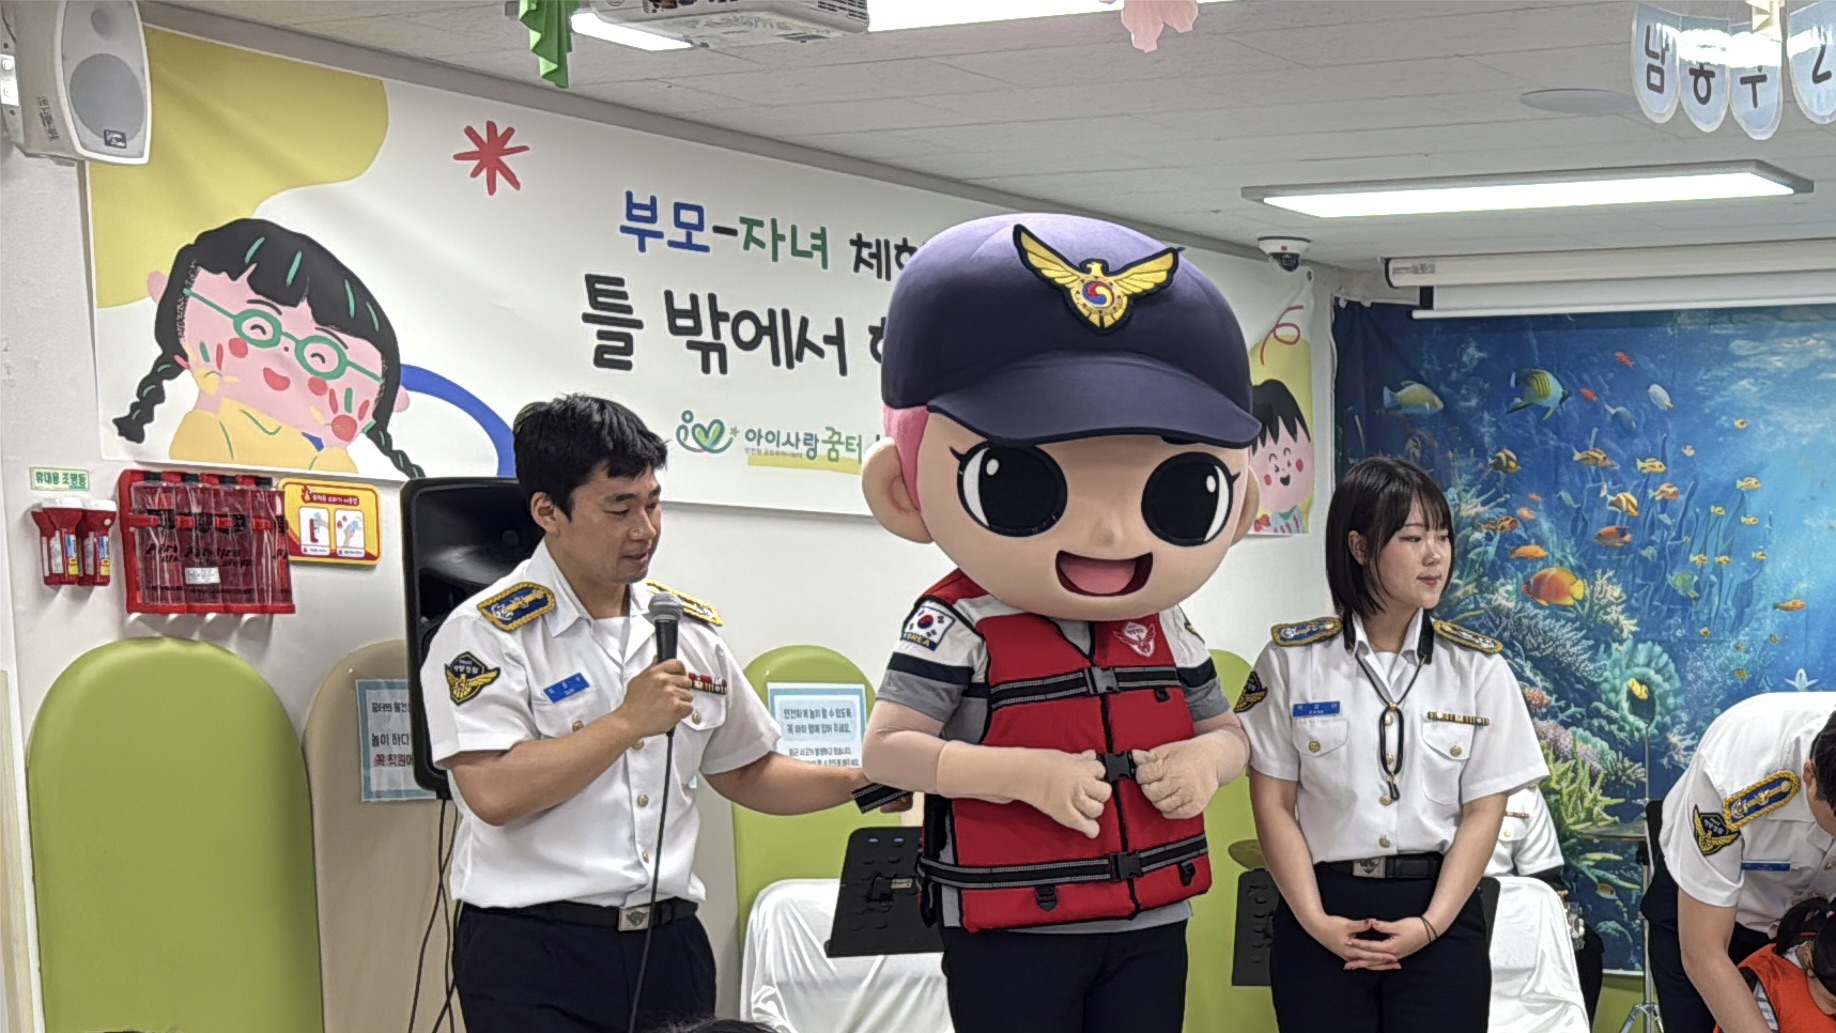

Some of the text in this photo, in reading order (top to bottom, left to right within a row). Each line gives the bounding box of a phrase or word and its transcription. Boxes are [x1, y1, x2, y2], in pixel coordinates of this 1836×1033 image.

[619, 190, 918, 281] 부모-자녀 체
[581, 273, 644, 371] 틀
[663, 289, 848, 377] 밖에서
[744, 426, 863, 464] 아이사랑꿈터
